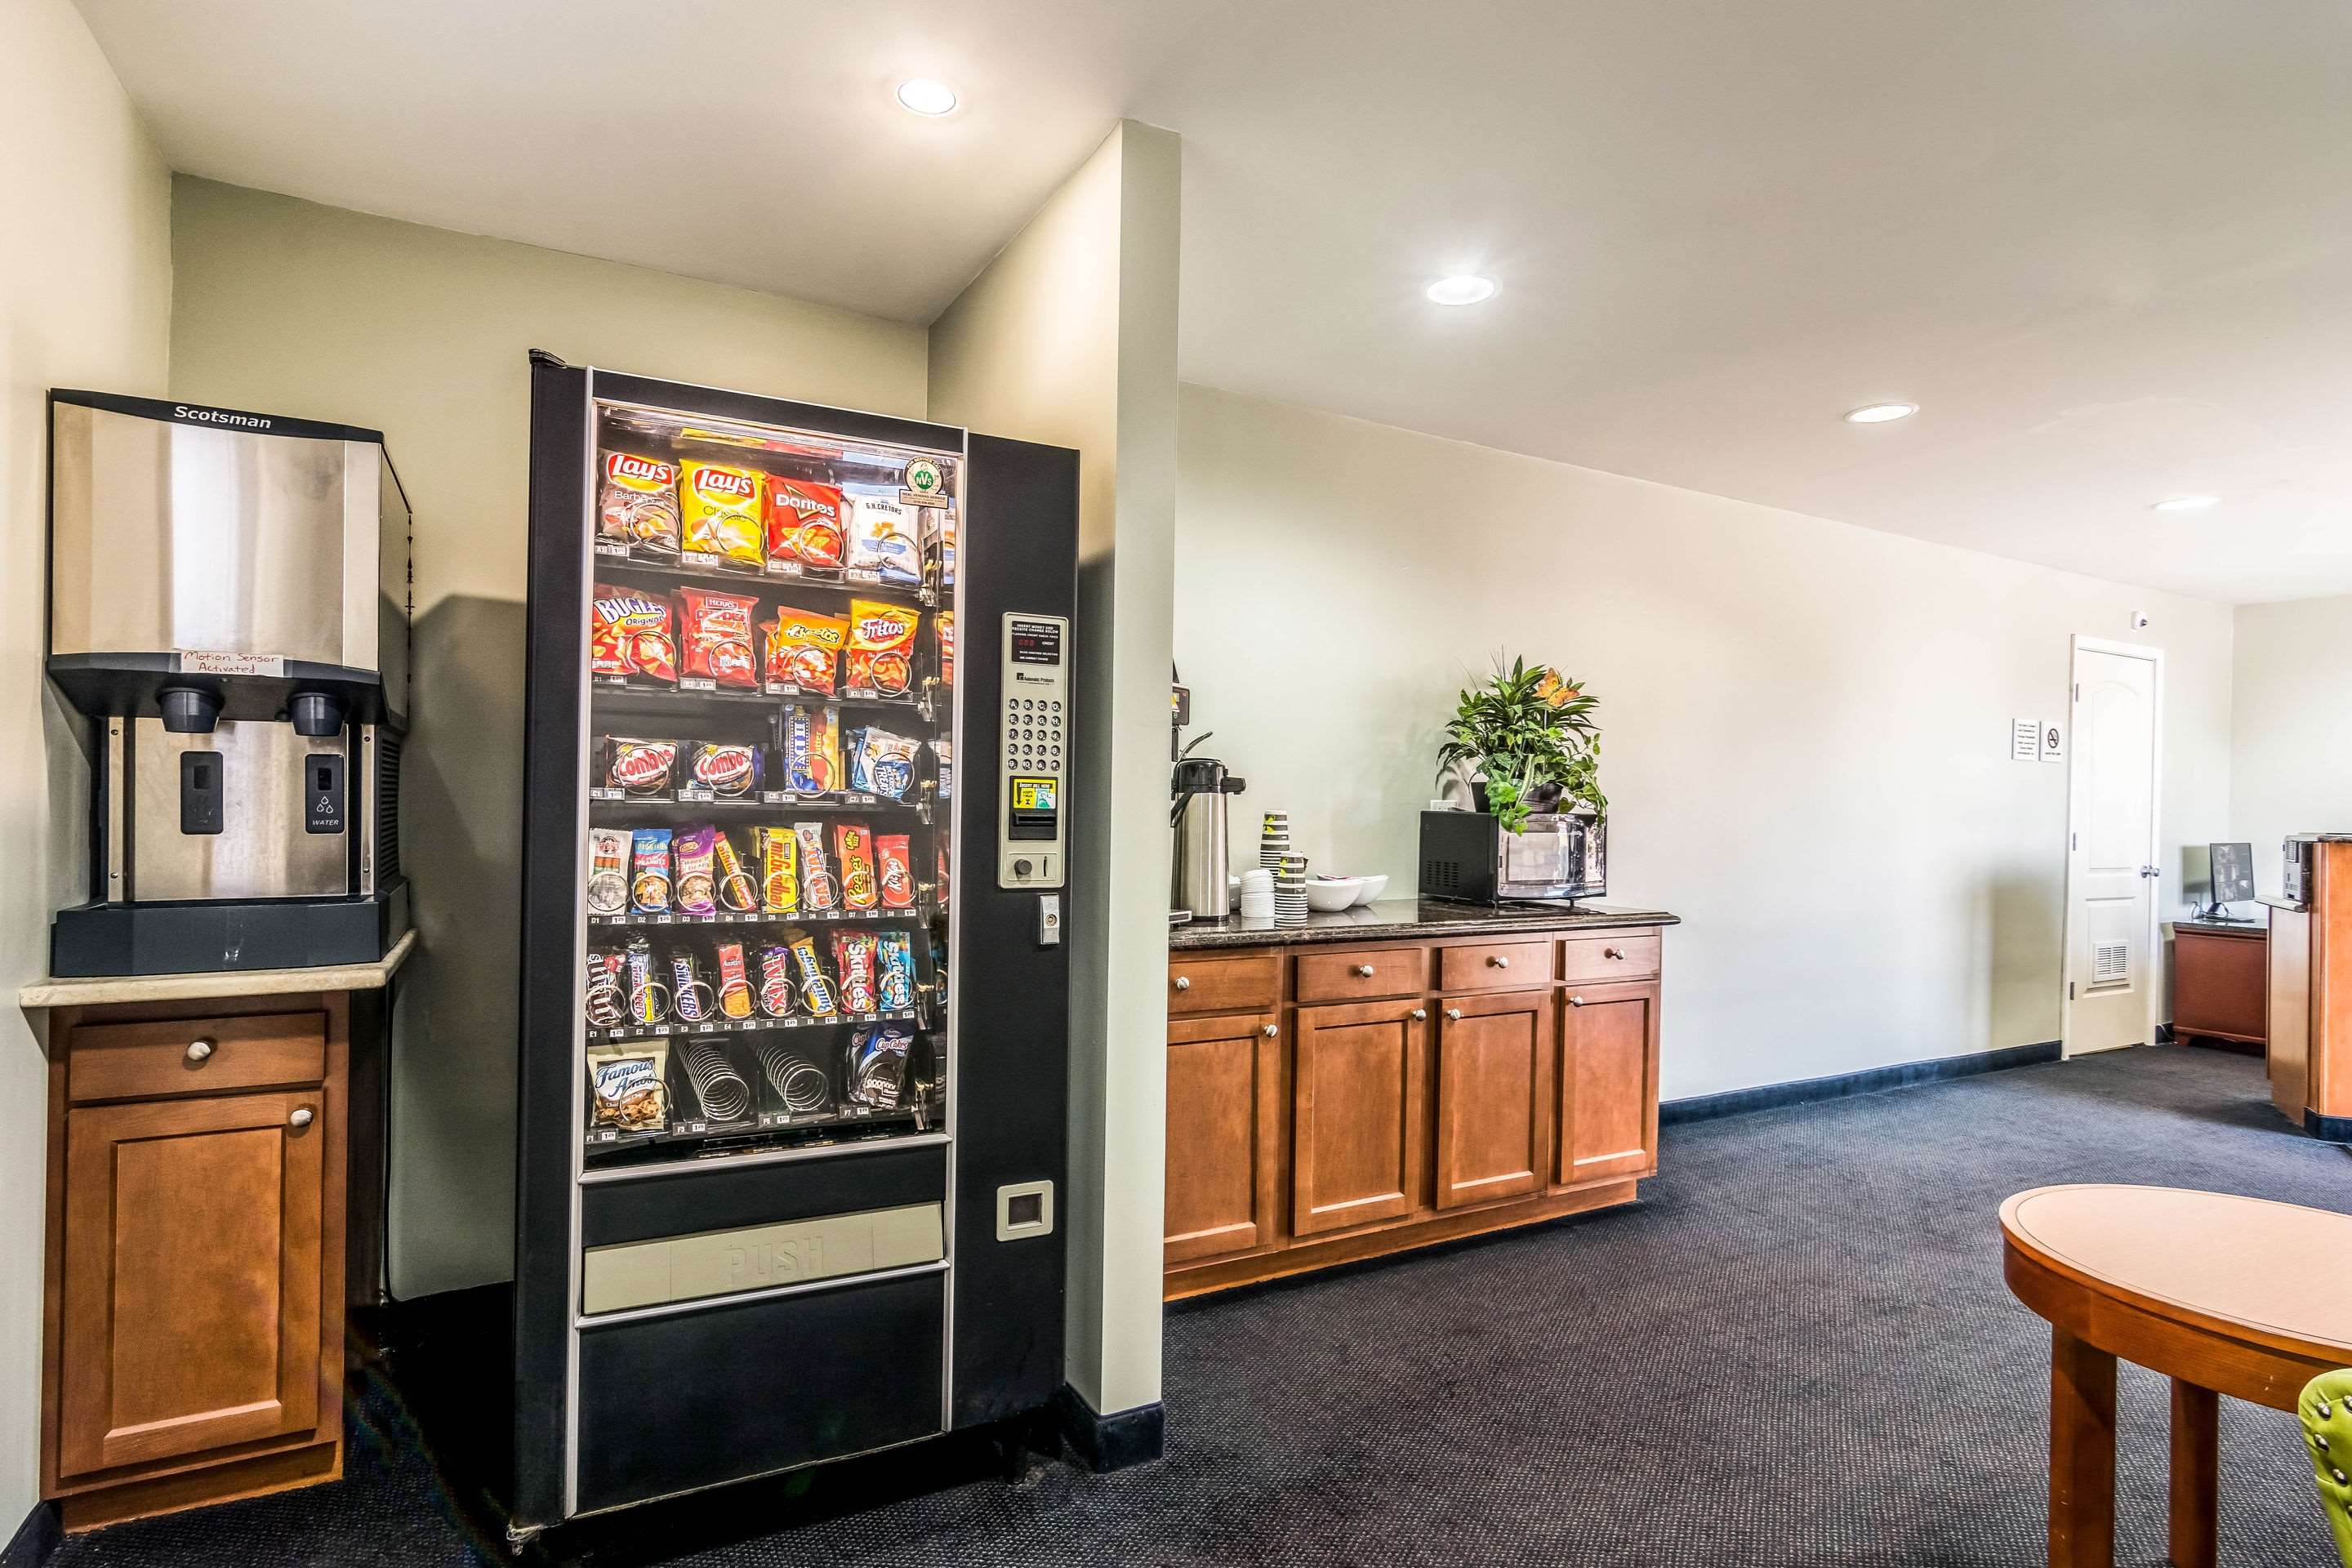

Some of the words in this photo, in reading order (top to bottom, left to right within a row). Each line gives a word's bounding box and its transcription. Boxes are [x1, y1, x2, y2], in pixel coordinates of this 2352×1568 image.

[173, 405, 272, 429] Scotsman
[612, 454, 673, 483] Lay's
[915, 472, 932, 486] NVS
[697, 470, 752, 494] Lay's
[614, 490, 665, 506] Barbe
[776, 492, 835, 518] Doritos
[594, 597, 666, 624] BUGLES
[861, 619, 905, 639] Fritos
[184, 651, 230, 662] Motion
[237, 653, 278, 662] Sensor
[198, 662, 256, 674] Activated
[793, 723, 806, 737] II
[617, 748, 674, 777] Combos
[699, 751, 751, 775] Combos
[792, 740, 806, 766] ACT
[875, 765, 889, 796] TREATS
[675, 963, 698, 1018] SNICKERS
[595, 1059, 654, 1089] Famous
[608, 1073, 653, 1098] Amos
[724, 1235, 825, 1285] PUSH
